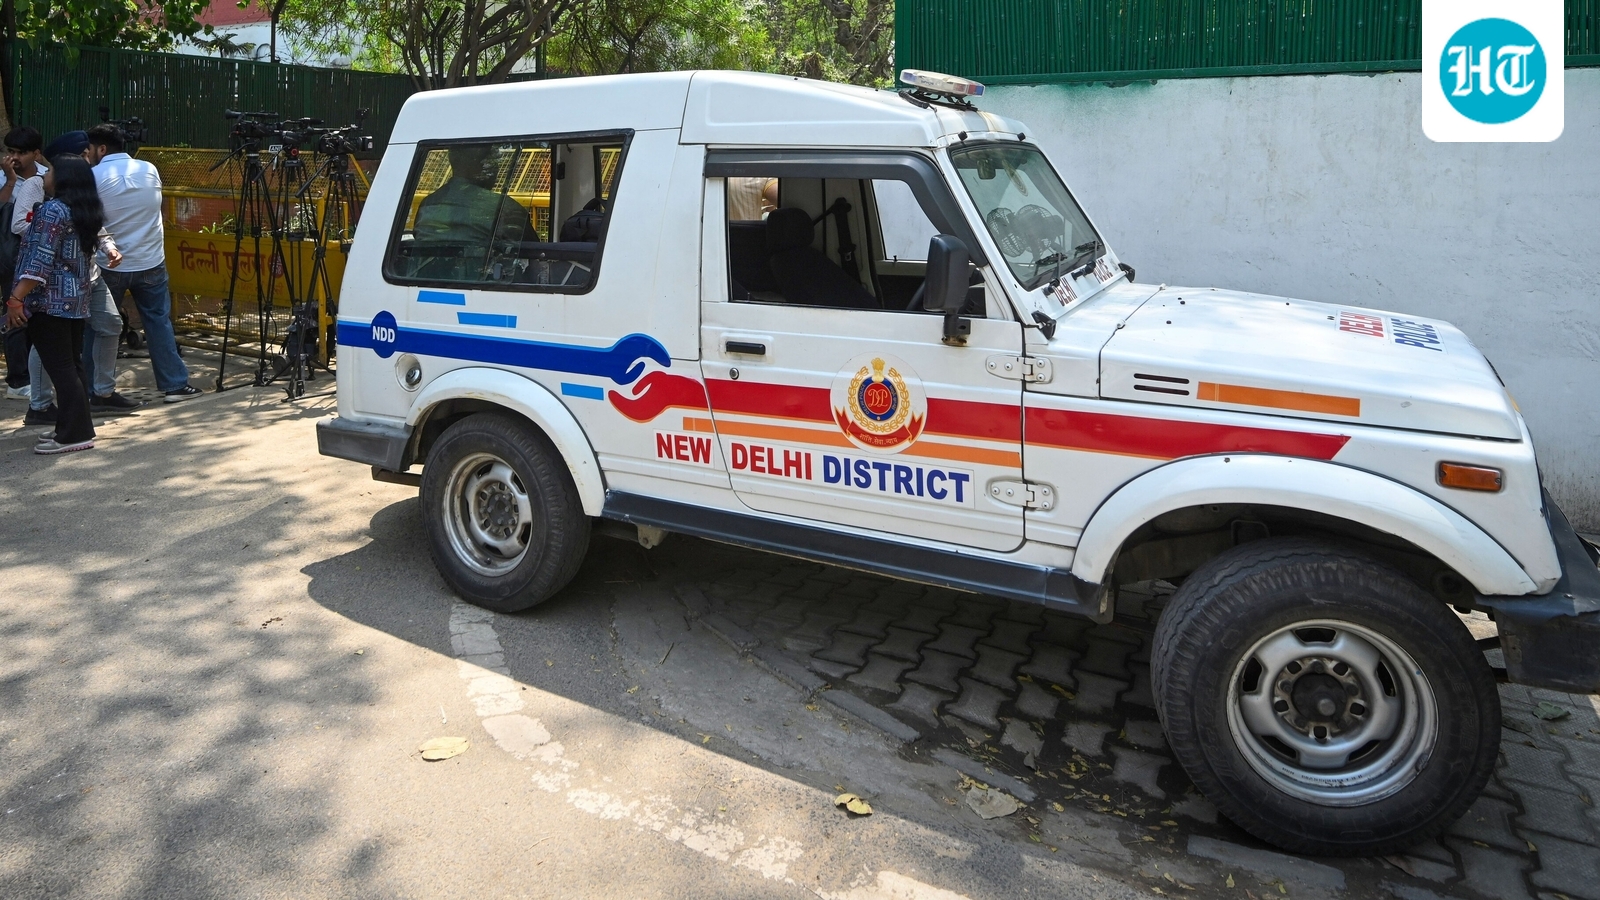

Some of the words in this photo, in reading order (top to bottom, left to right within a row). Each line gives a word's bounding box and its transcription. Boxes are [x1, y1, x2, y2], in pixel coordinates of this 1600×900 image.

[177, 240, 220, 275] दिल्ली
[1054, 277, 1078, 307] DELHI
[372, 325, 396, 343] NDD
[1339, 310, 1384, 338] DELHI
[1390, 318, 1443, 352] POLICE
[656, 432, 712, 465] NEW
[731, 442, 812, 481] DELHI
[822, 454, 970, 503] DISTRICT
